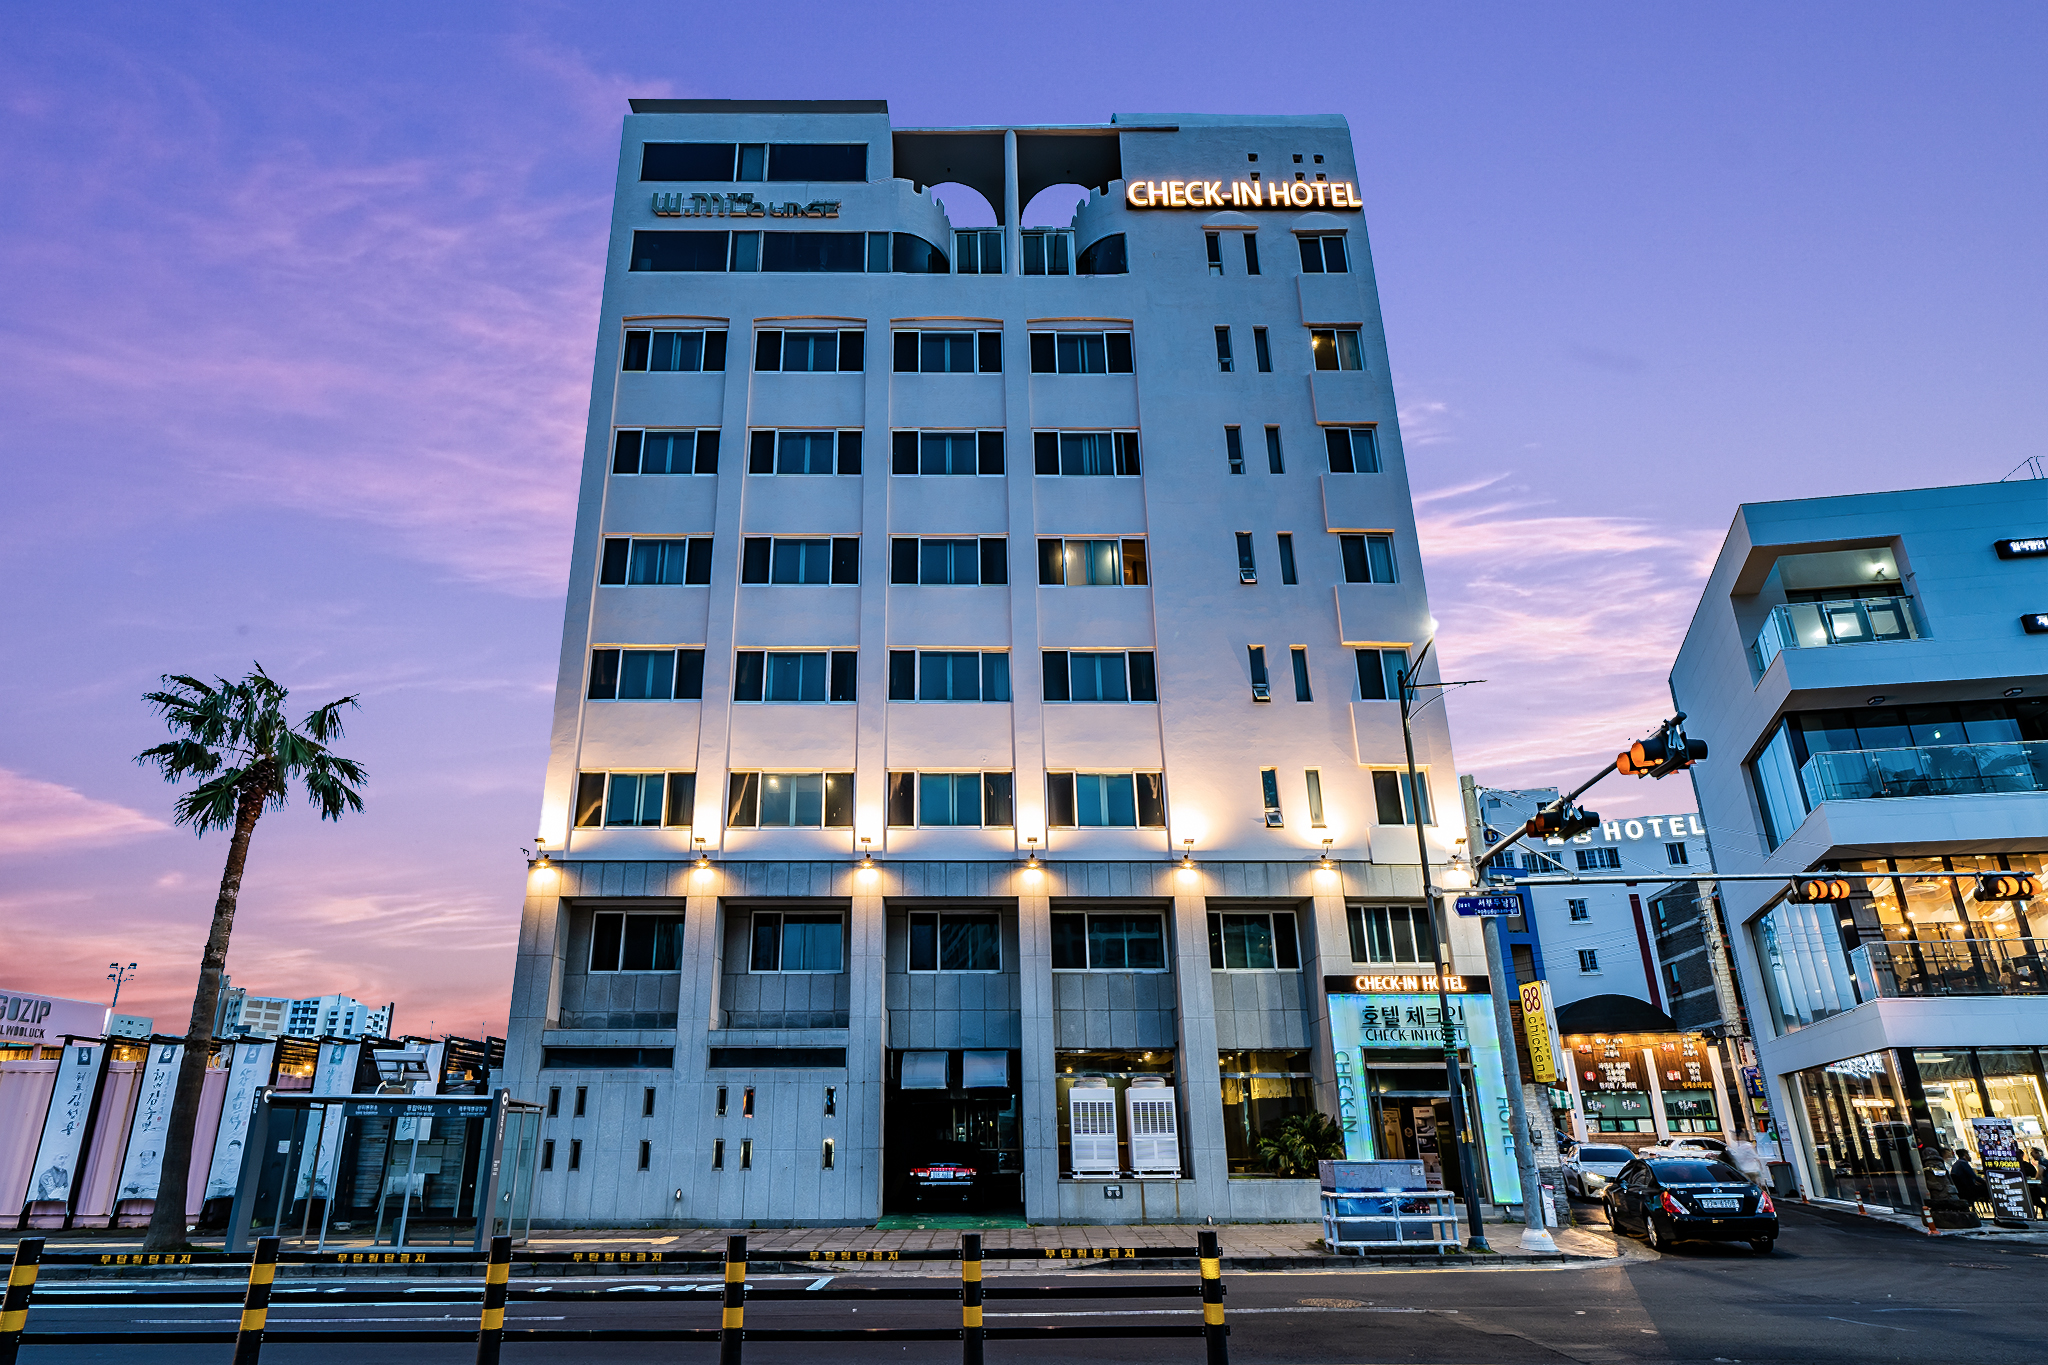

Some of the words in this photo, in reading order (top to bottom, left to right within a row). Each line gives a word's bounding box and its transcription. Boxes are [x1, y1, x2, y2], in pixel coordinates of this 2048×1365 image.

[1127, 180, 1263, 207] CHECK-IN
[1268, 181, 1363, 208] HOTEL
[1602, 815, 1706, 842] HOTEL
[1356, 975, 1419, 991] CHECK-IN
[1523, 986, 1541, 1013] 88
[1361, 1005, 1401, 1027] 호텔
[1406, 1005, 1465, 1028] 체크인
[1335, 1051, 1358, 1133] CHECK-IN
